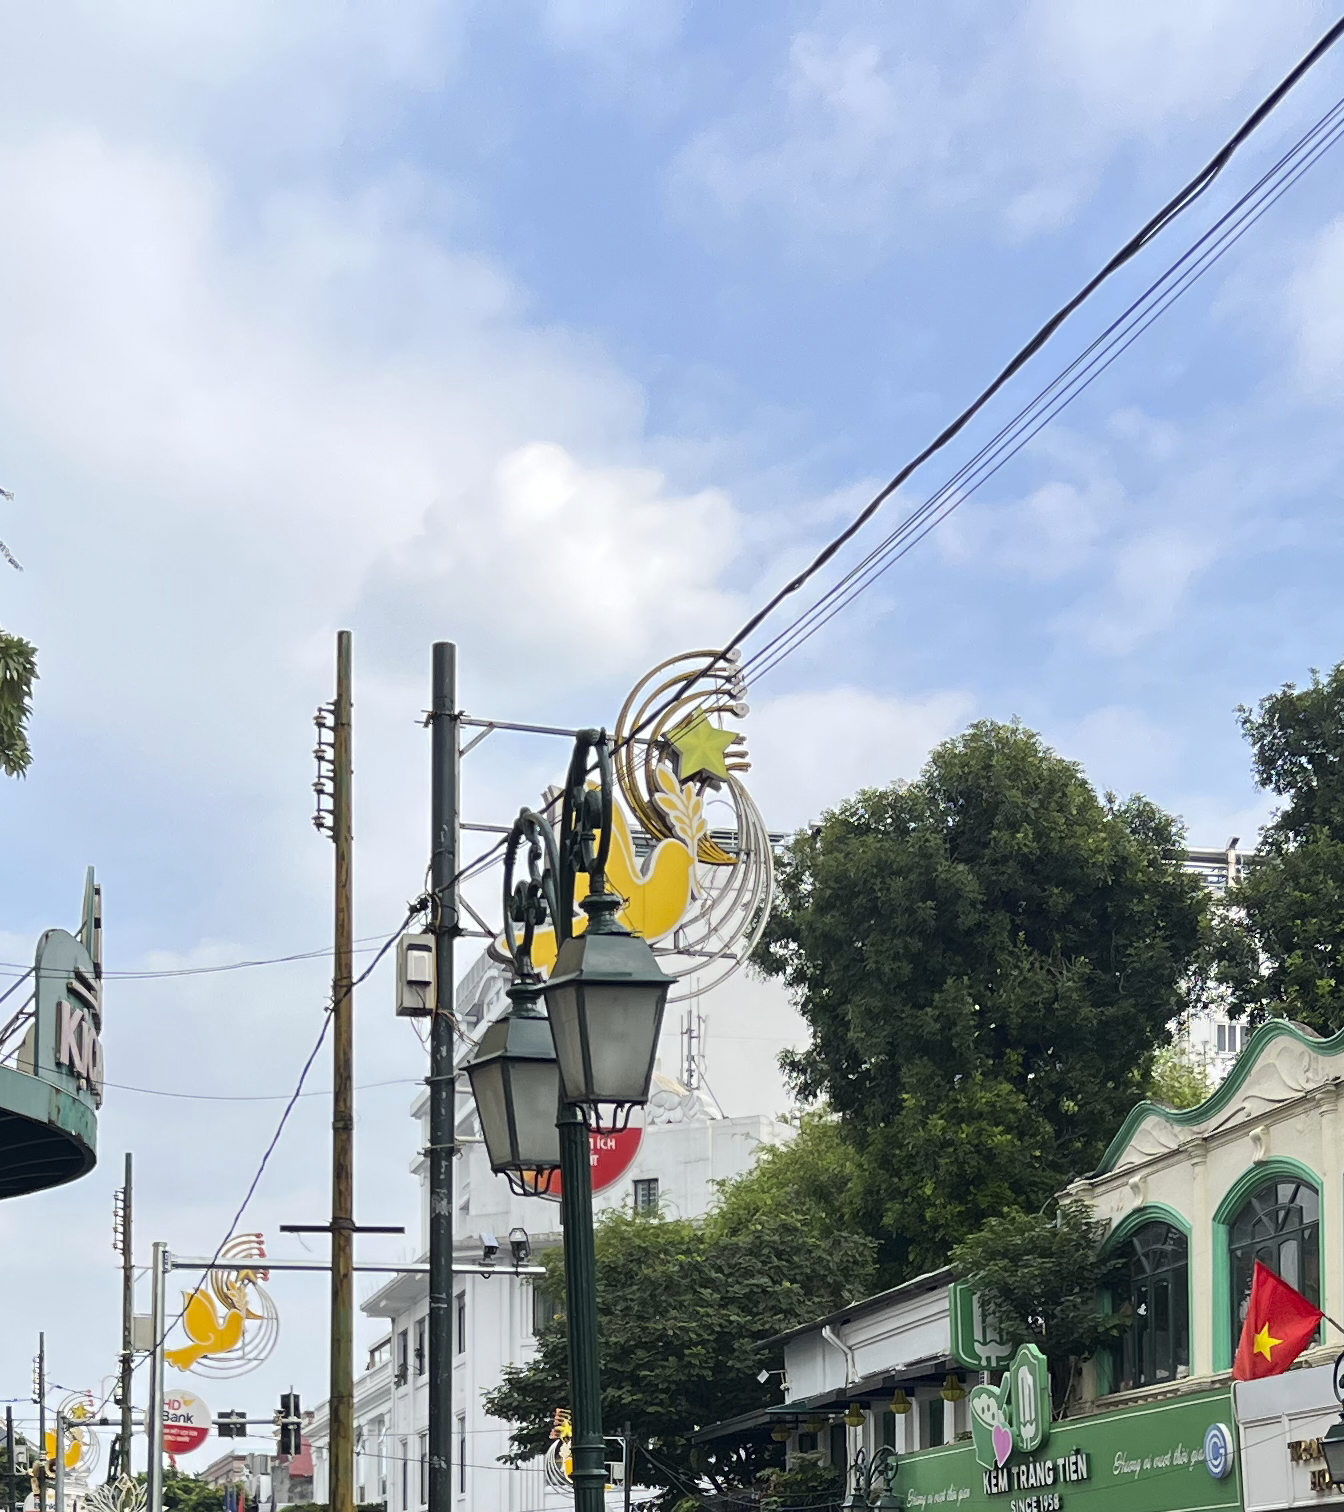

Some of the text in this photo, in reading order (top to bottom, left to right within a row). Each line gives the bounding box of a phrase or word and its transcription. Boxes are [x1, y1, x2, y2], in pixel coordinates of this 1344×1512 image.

[162, 1411, 195, 1425] Bank
[983, 1445, 1088, 1495] KEM TRÀNG TIỀN
[1039, 1493, 1060, 1512] 1958
